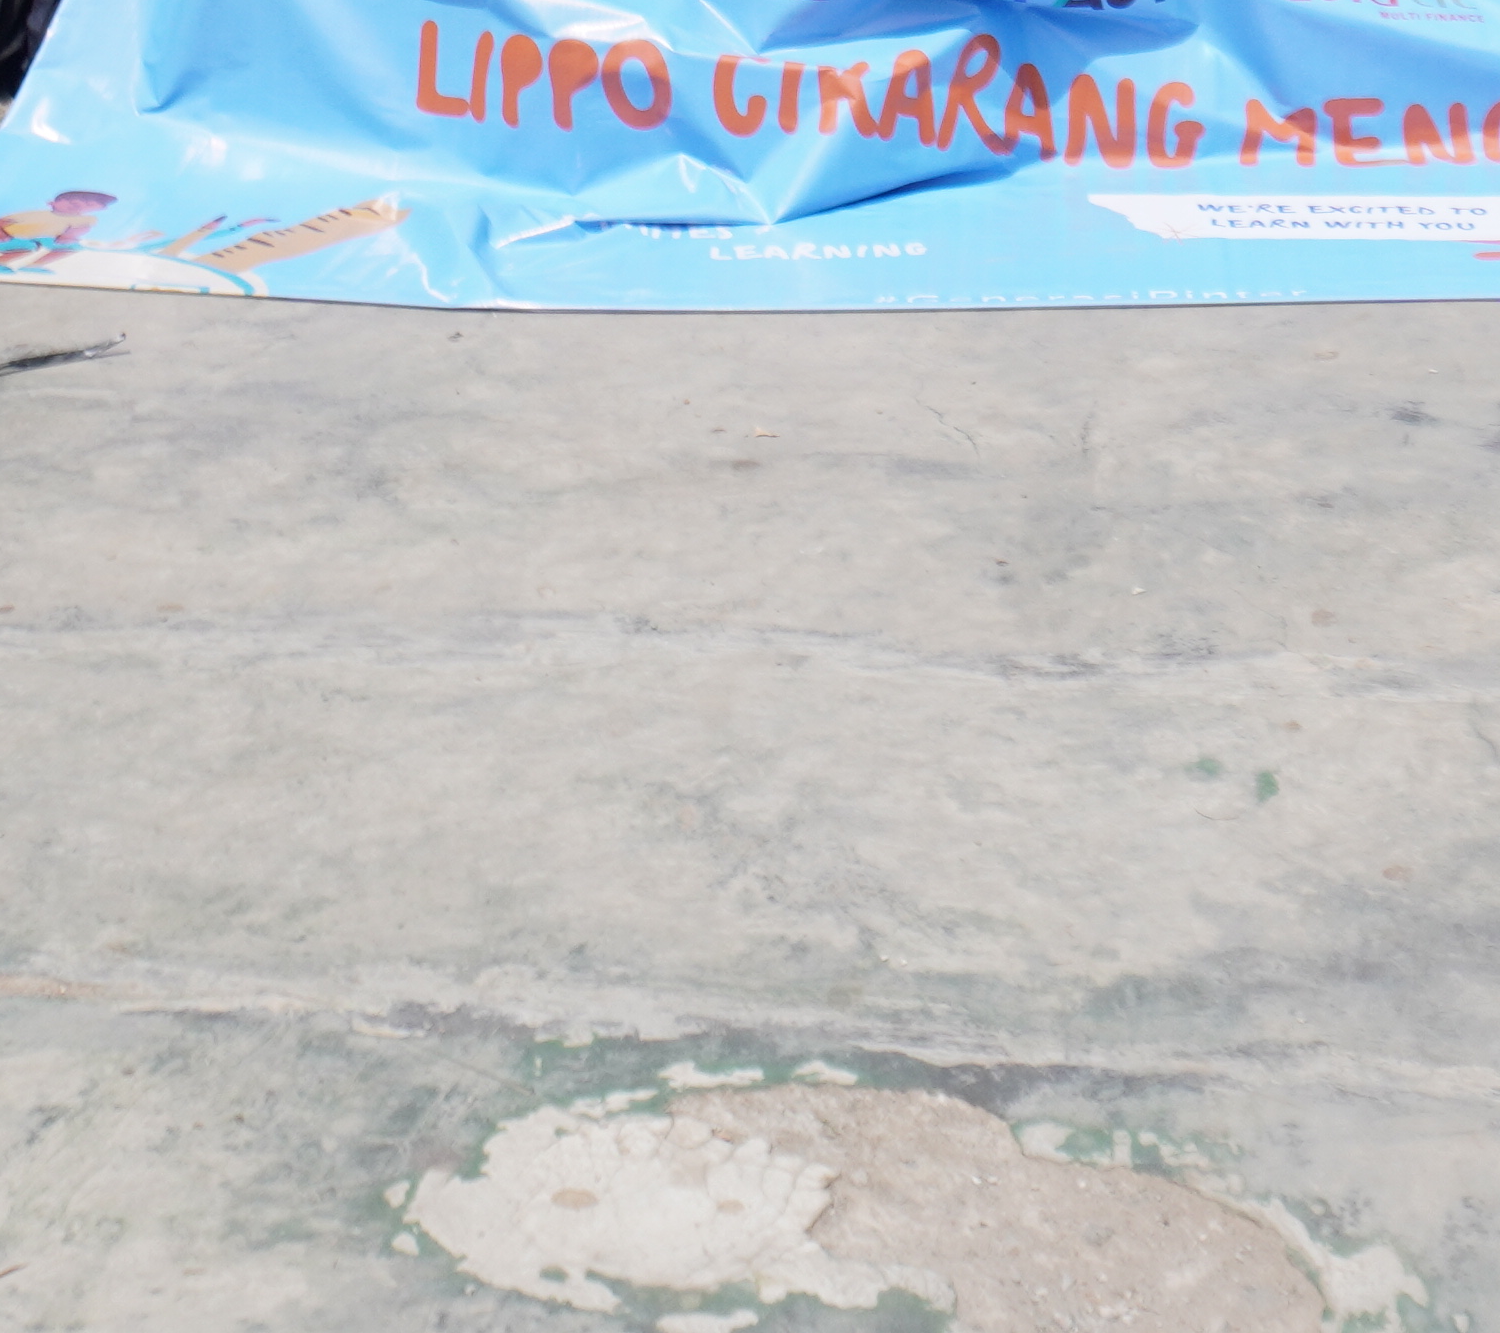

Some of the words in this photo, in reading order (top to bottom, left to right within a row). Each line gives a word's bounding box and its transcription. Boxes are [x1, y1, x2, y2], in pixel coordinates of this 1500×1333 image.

[415, 19, 673, 132] LIPPO
[712, 32, 1207, 170] CIKARANG
[1308, 204, 1436, 216] EXCITED
[1450, 206, 1488, 217] TO
[1210, 218, 1311, 229] LEARN
[1324, 219, 1405, 230] WITH
[1418, 221, 1477, 231] YOU
[709, 242, 929, 261] LEARNING
